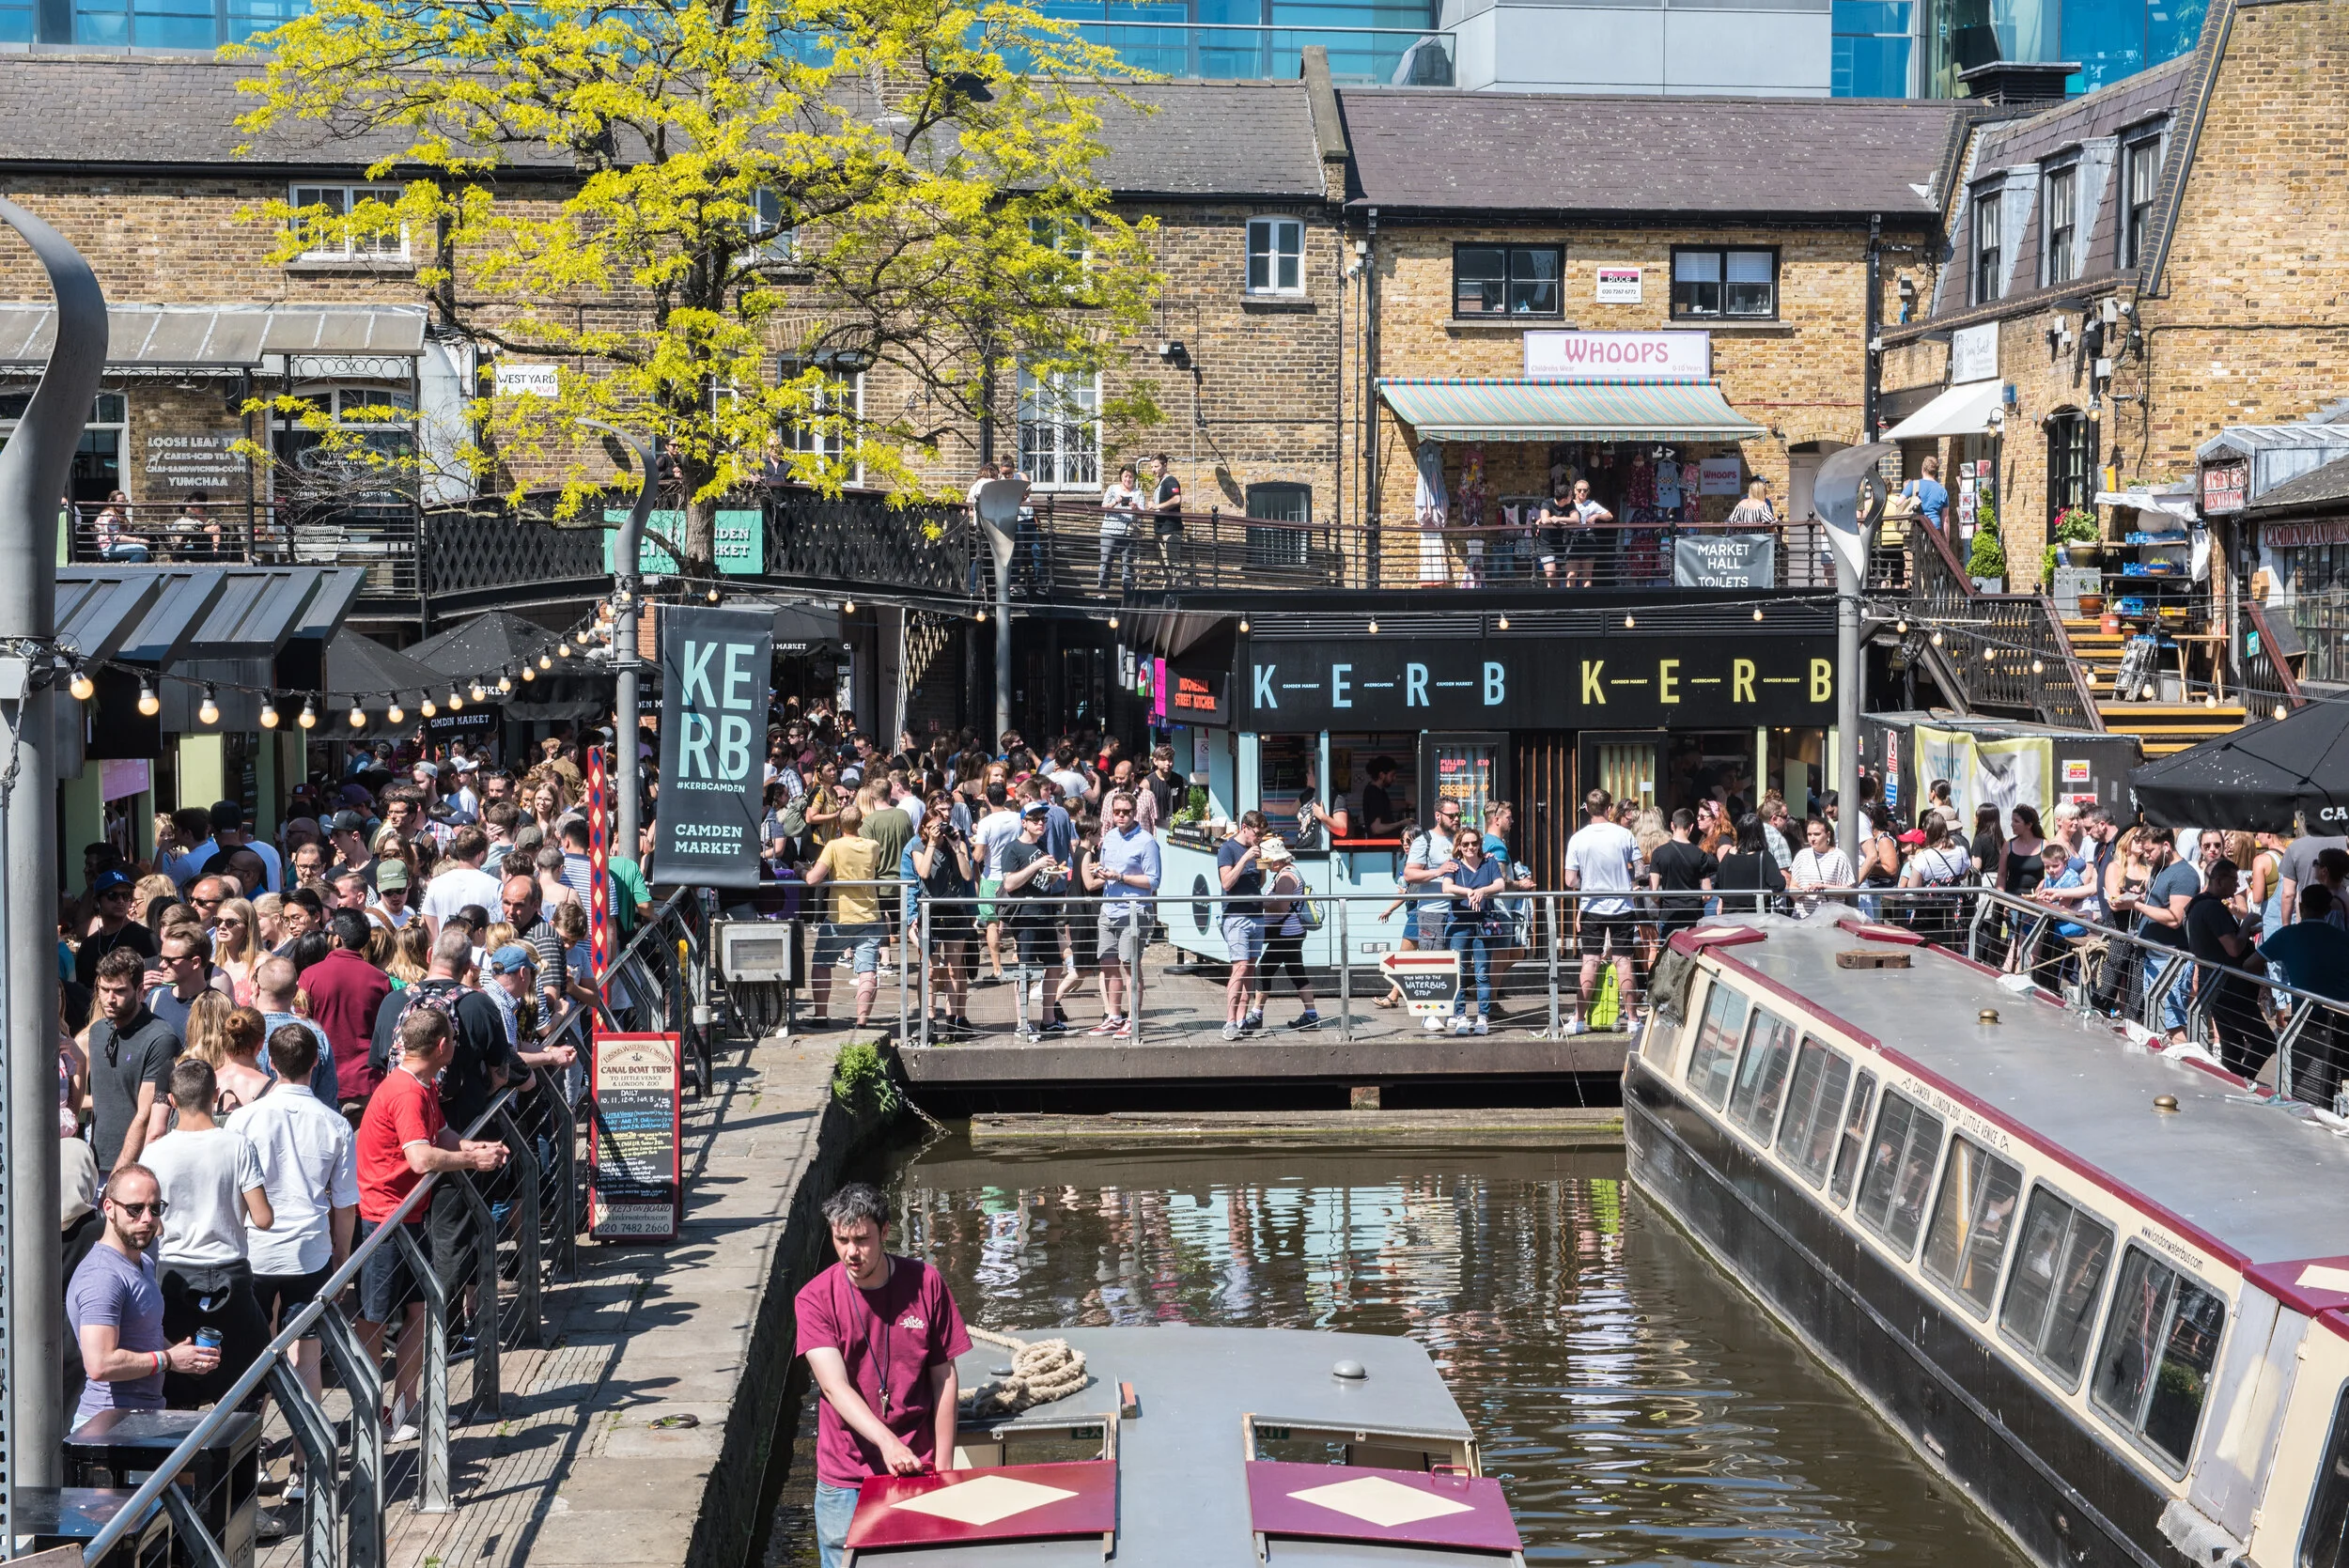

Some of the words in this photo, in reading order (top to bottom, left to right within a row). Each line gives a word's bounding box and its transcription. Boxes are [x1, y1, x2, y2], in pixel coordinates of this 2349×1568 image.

[1608, 273, 1632, 282] Bruce
[1564, 339, 1669, 364] WHOOPS
[497, 374, 526, 383] WEST
[528, 374, 555, 383] YARD
[148, 437, 188, 447] LOOSE
[191, 437, 219, 447] LEAF
[1703, 471, 1737, 479] WHOOPS
[168, 476, 228, 487] YUMCHAA
[2264, 523, 2303, 547] CAMDEN
[2303, 521, 2333, 546] PIANO
[1698, 544, 1749, 555] MARKET
[1708, 557, 1740, 569] HALL
[1698, 576, 1749, 587] TOILETS
[457, 714, 490, 725] MARKET
[677, 781, 745, 793] #KERBCAMDEN
[2320, 807, 2348, 821] CA
[676, 824, 742, 838] CAMDEN
[675, 841, 741, 855] MARKET
[1405, 981, 1447, 989] WATERBUS
[1913, 1082, 1930, 1101] CAMDEN
[1933, 1094, 1951, 1114] LONDON
[1950, 1105, 1961, 1121] ZOO
[1963, 1112, 1981, 1134] LITTLE
[1981, 1123, 1999, 1144] VENICE
[598, 1223, 617, 1233] 020
[621, 1223, 643, 1233] 7482
[646, 1223, 670, 1233] 2660
